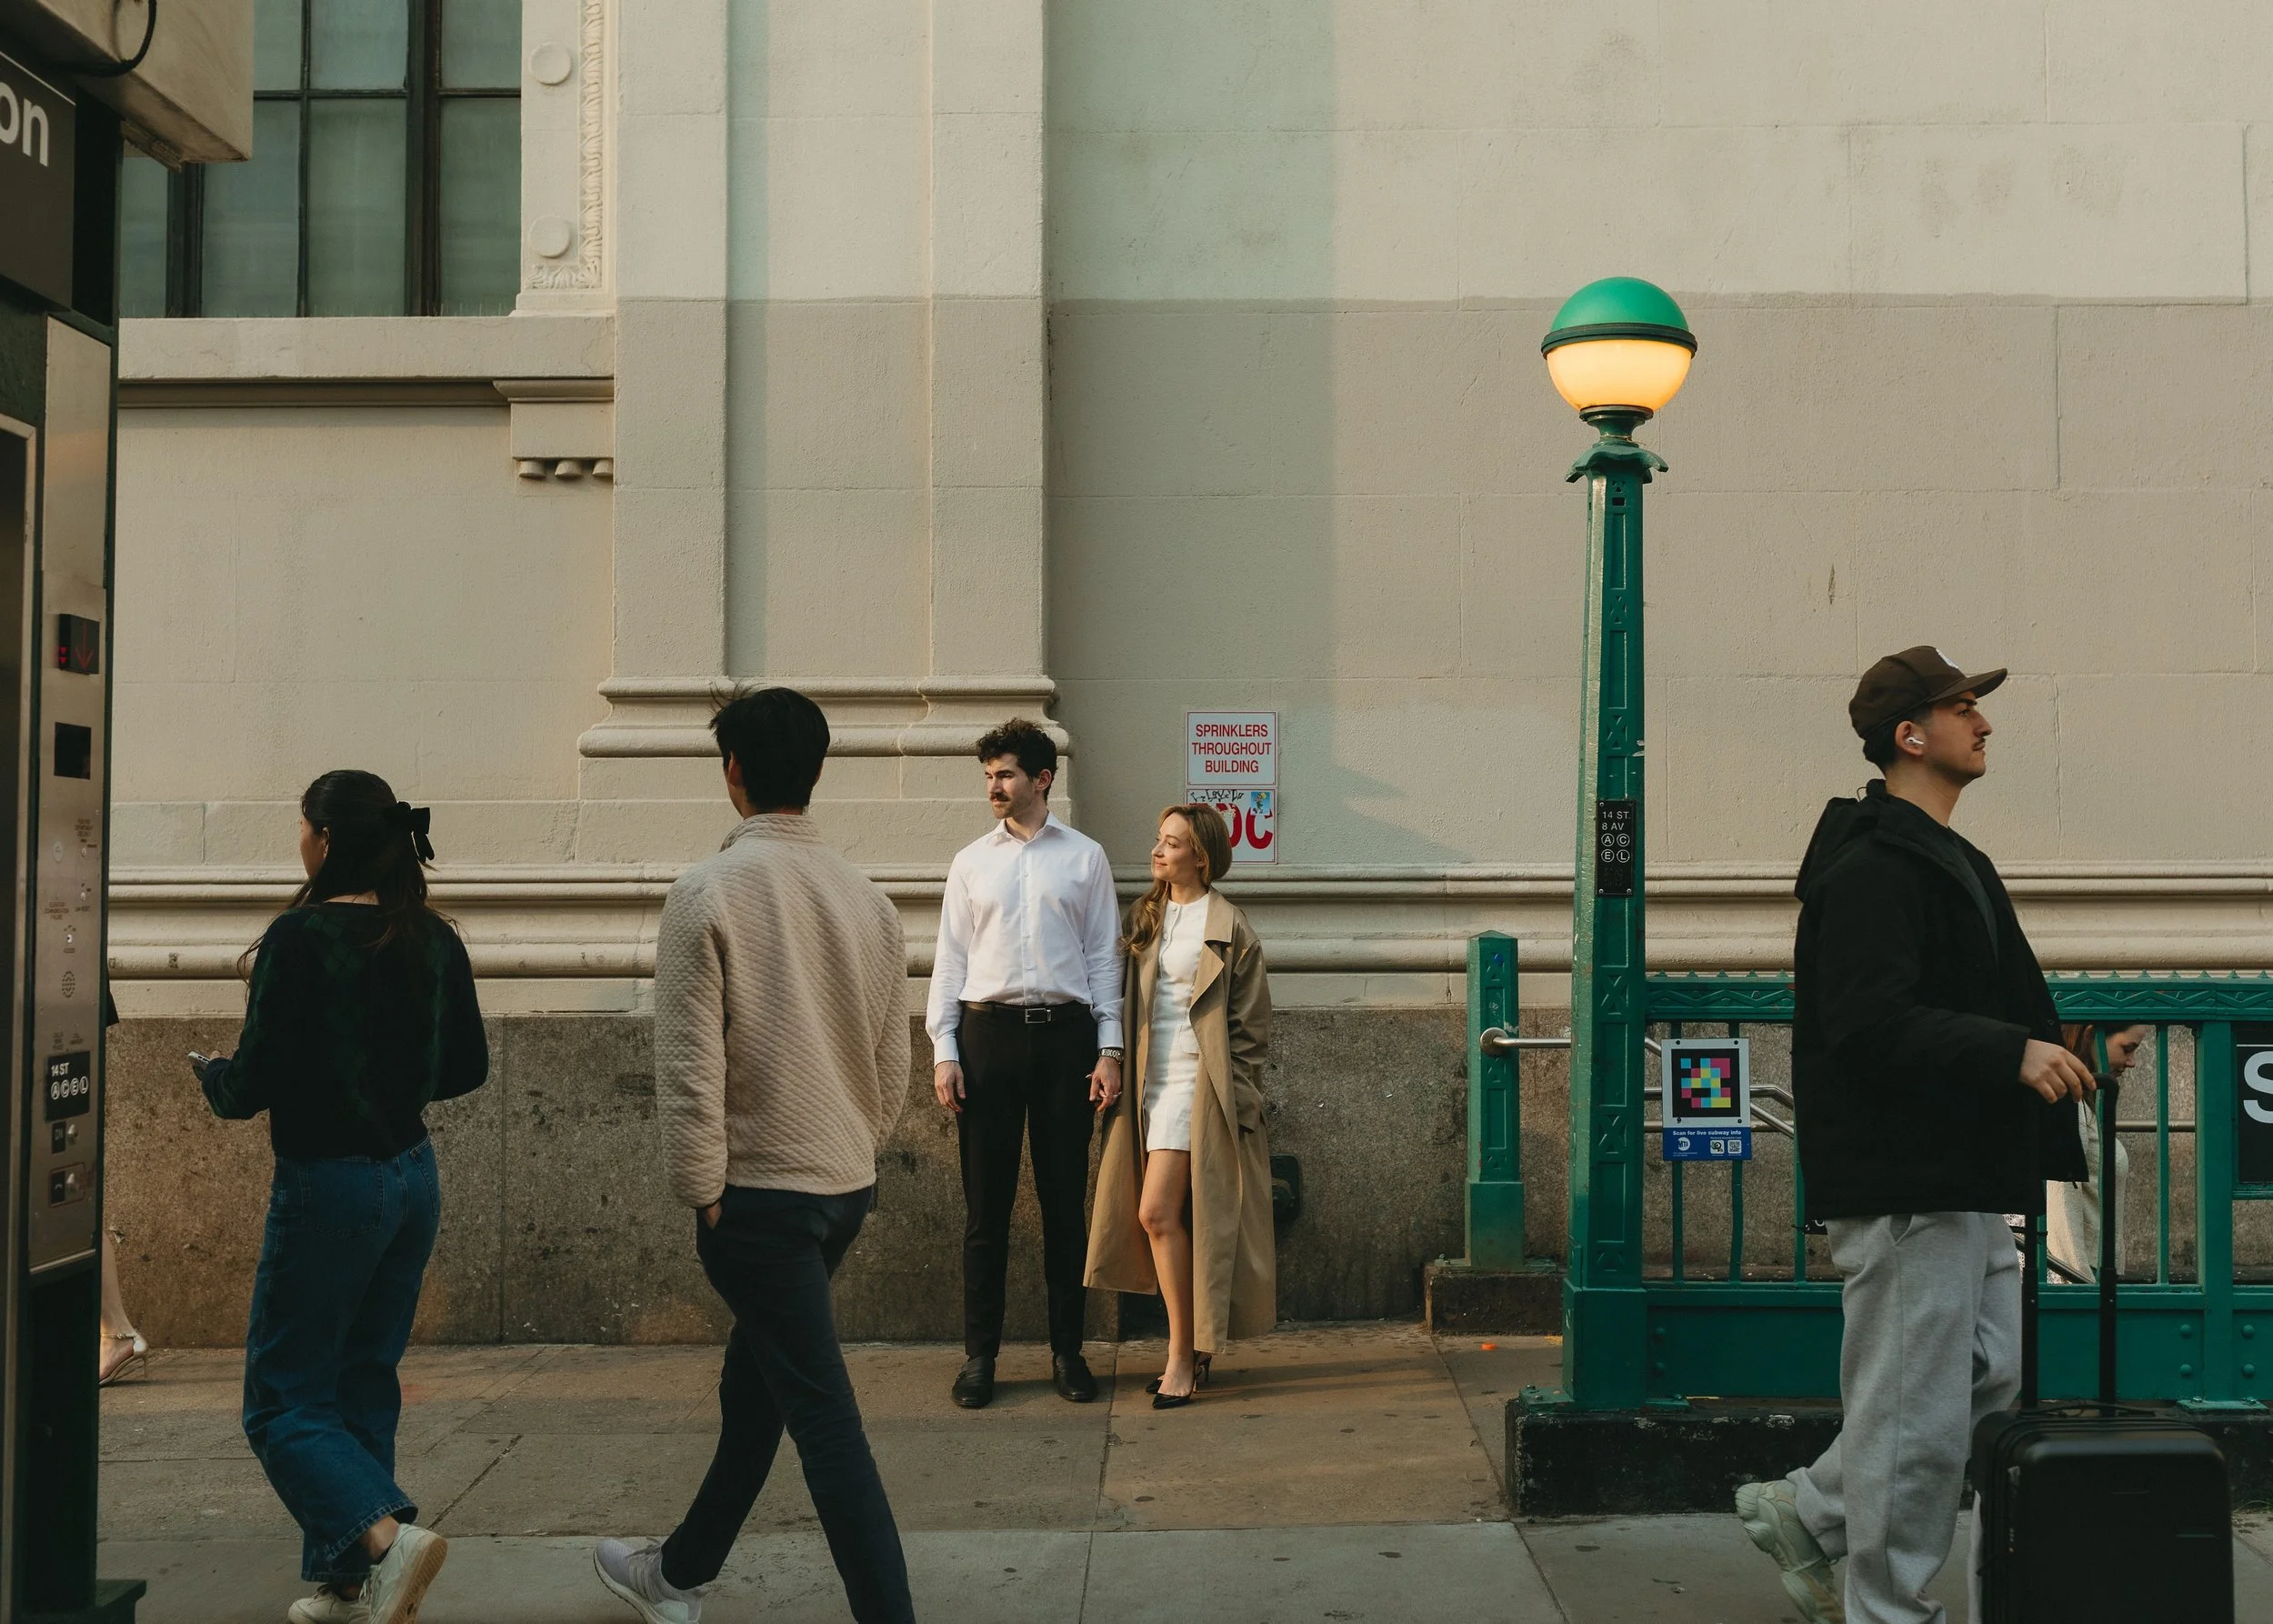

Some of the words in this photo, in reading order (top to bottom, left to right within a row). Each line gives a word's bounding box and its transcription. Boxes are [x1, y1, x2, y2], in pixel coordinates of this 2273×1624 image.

[1196, 725, 1268, 737] SPRINKLERS
[1192, 742, 1272, 755] THROUGHOUT
[1205, 760, 1259, 773] BUILDING
[1602, 811, 1613, 819] 14
[1601, 822, 1608, 830] 8
[1610, 822, 1625, 830] AV
[51, 1064, 59, 1077] 14
[59, 1062, 70, 1076] ST
